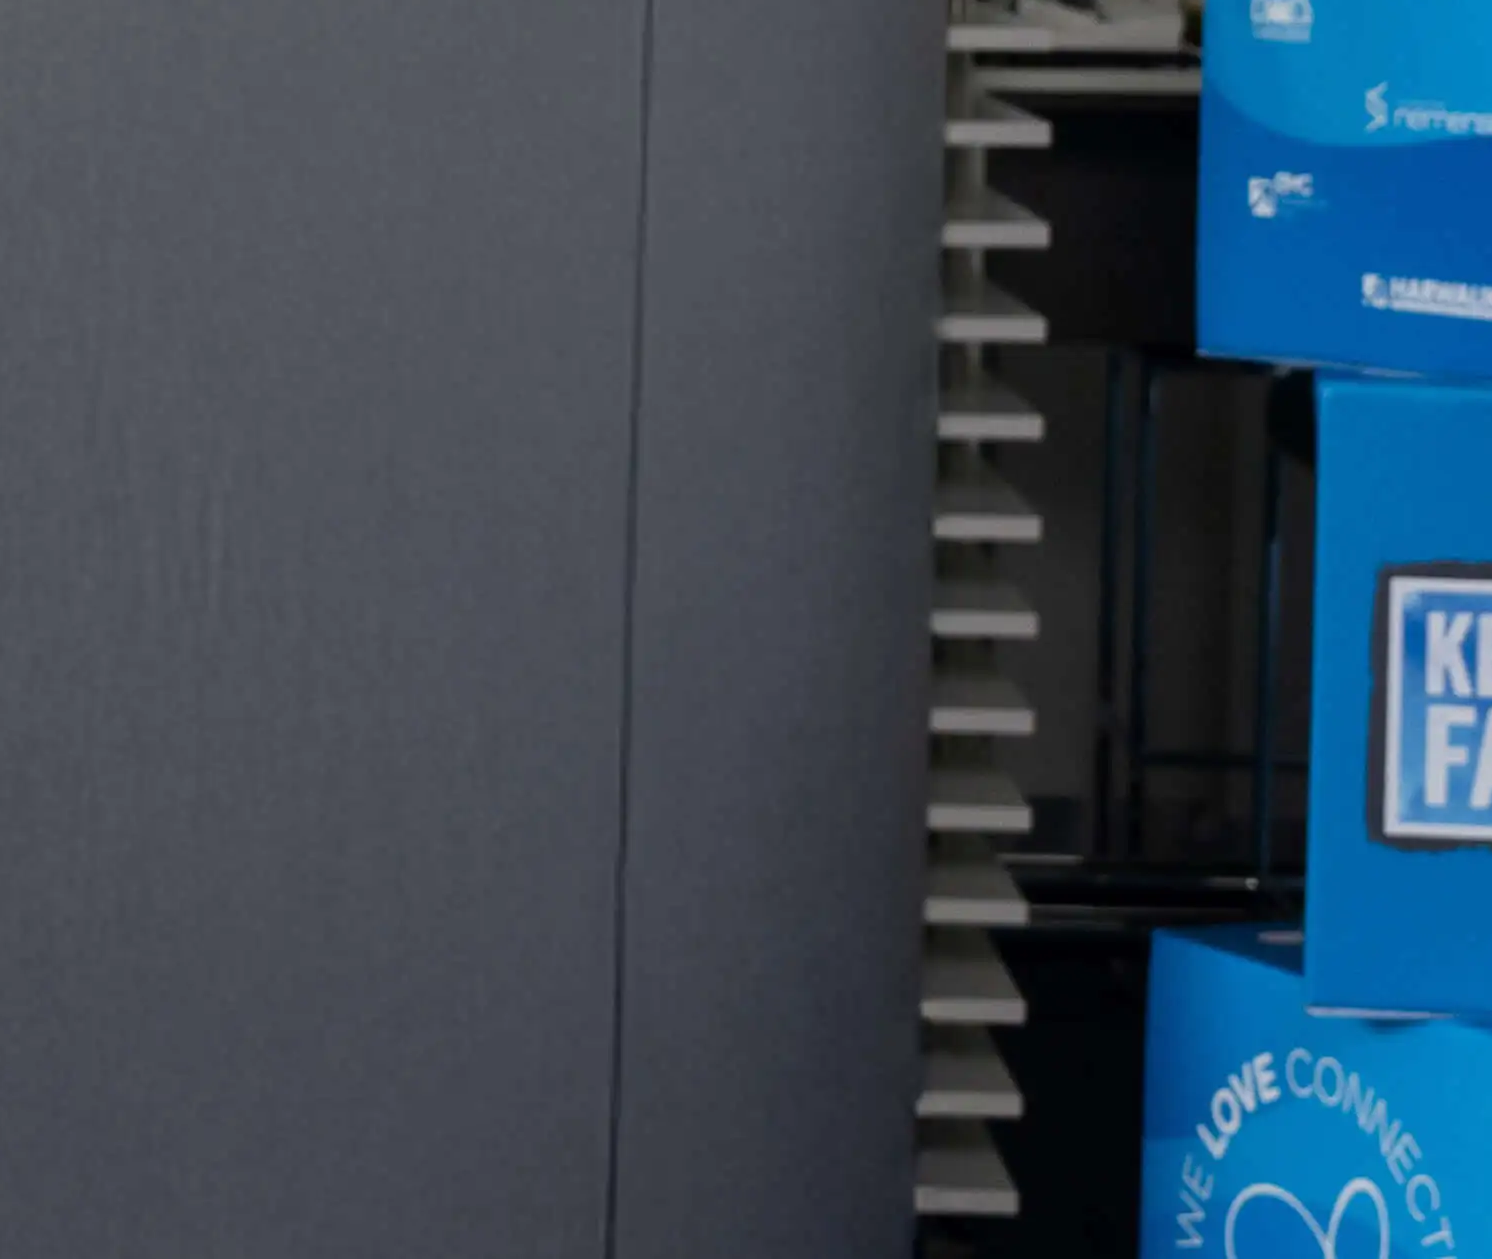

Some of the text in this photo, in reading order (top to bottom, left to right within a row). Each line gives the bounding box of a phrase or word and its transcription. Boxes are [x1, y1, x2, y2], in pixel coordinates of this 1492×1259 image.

[1175, 1047, 1457, 1259] WE LOVE CONNECT
